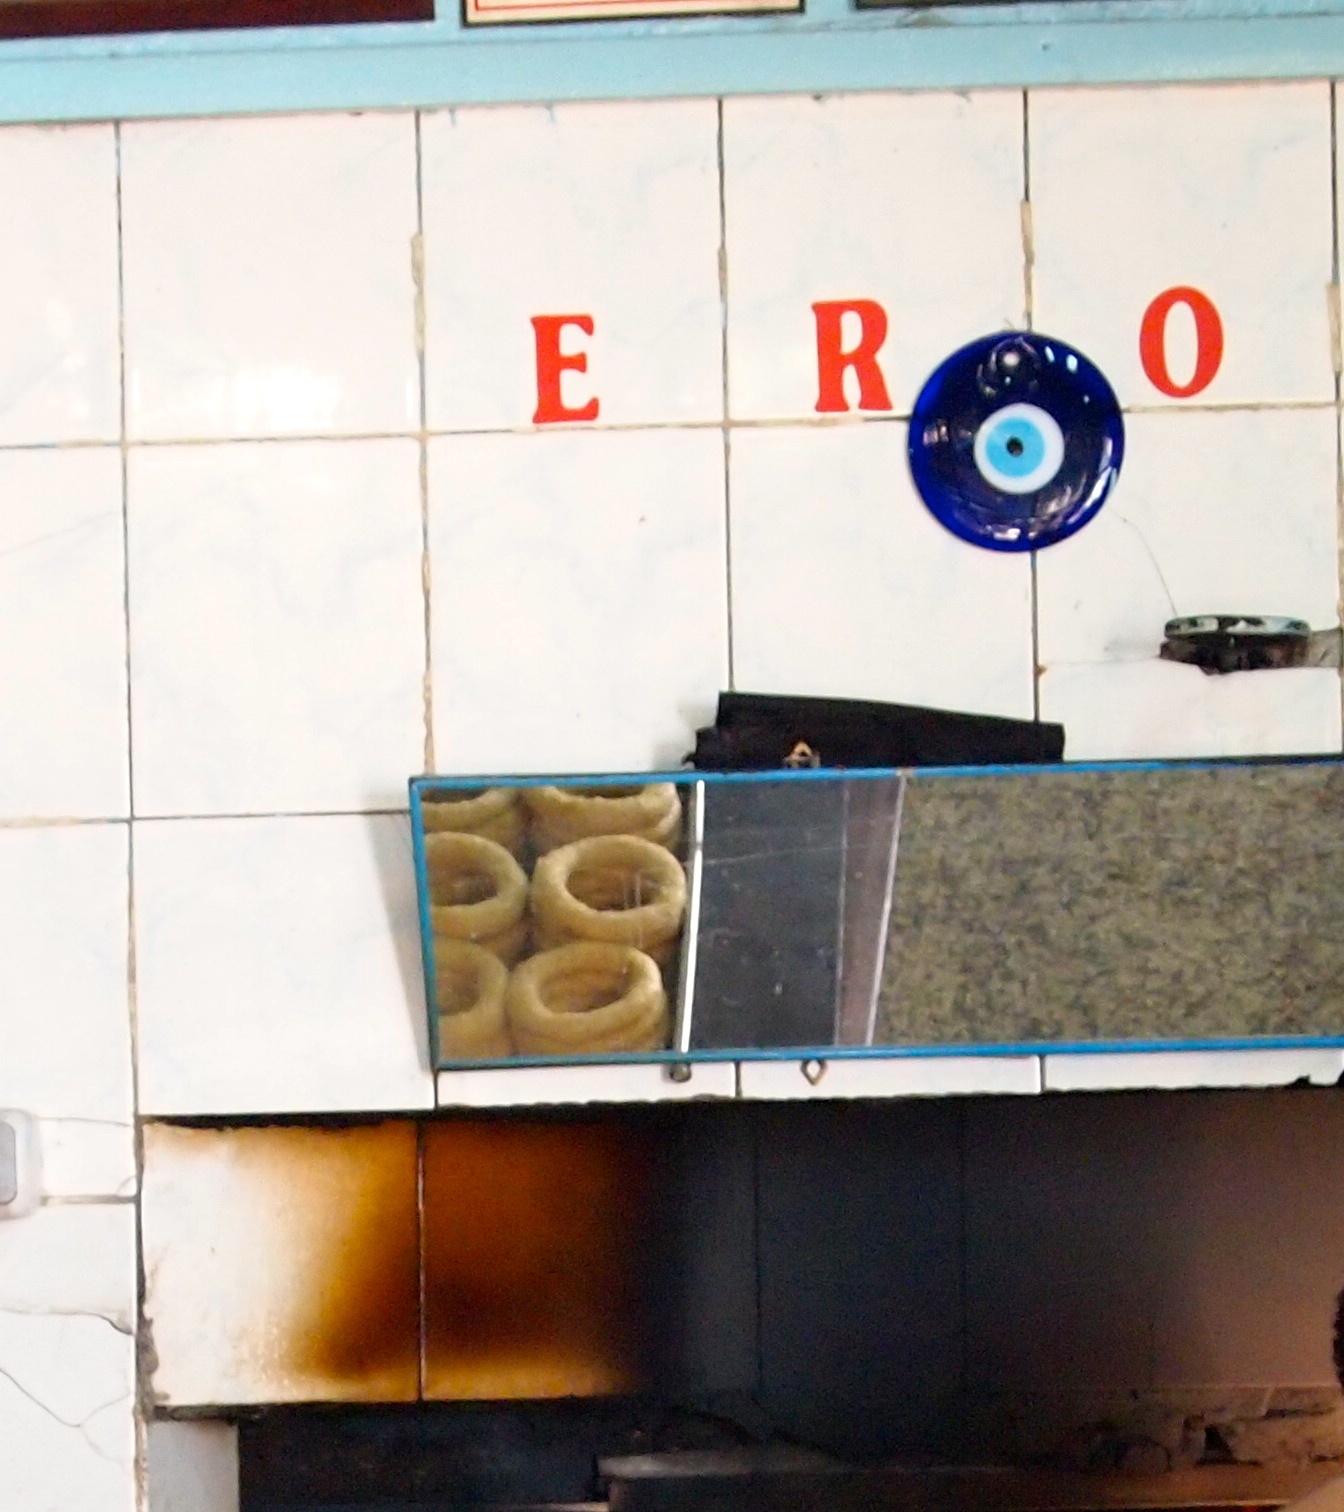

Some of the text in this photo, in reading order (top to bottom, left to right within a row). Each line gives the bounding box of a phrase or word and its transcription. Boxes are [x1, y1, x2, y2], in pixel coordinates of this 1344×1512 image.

[531, 315, 599, 424] E
[812, 300, 892, 413] R
[1139, 287, 1224, 398] O
